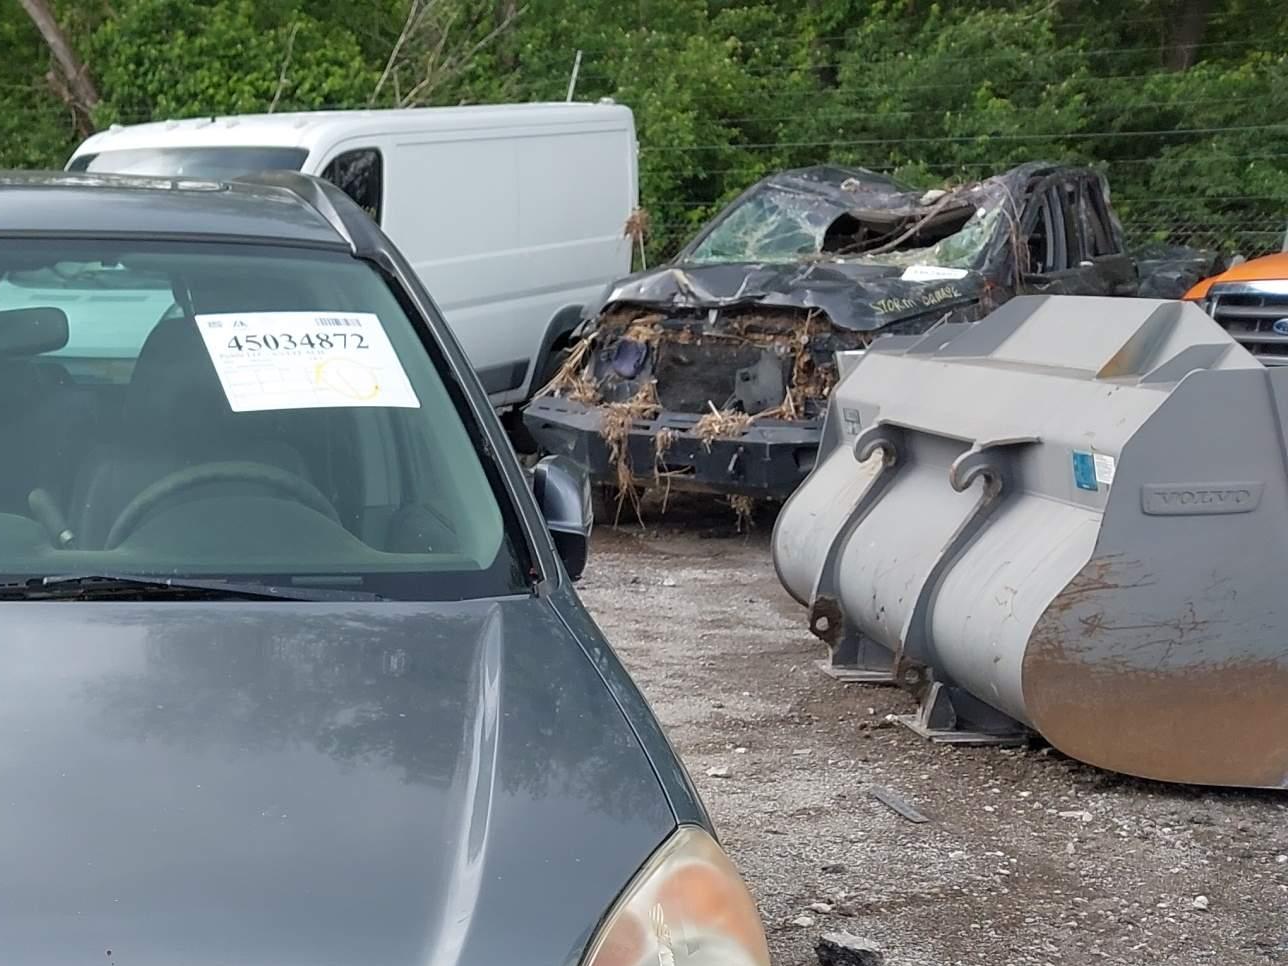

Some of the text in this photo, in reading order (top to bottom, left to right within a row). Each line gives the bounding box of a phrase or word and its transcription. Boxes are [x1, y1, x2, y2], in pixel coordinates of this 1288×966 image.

[870, 298, 917, 315] STORM
[228, 333, 369, 351] 45034872
[1153, 488, 1252, 505] VOLVO
